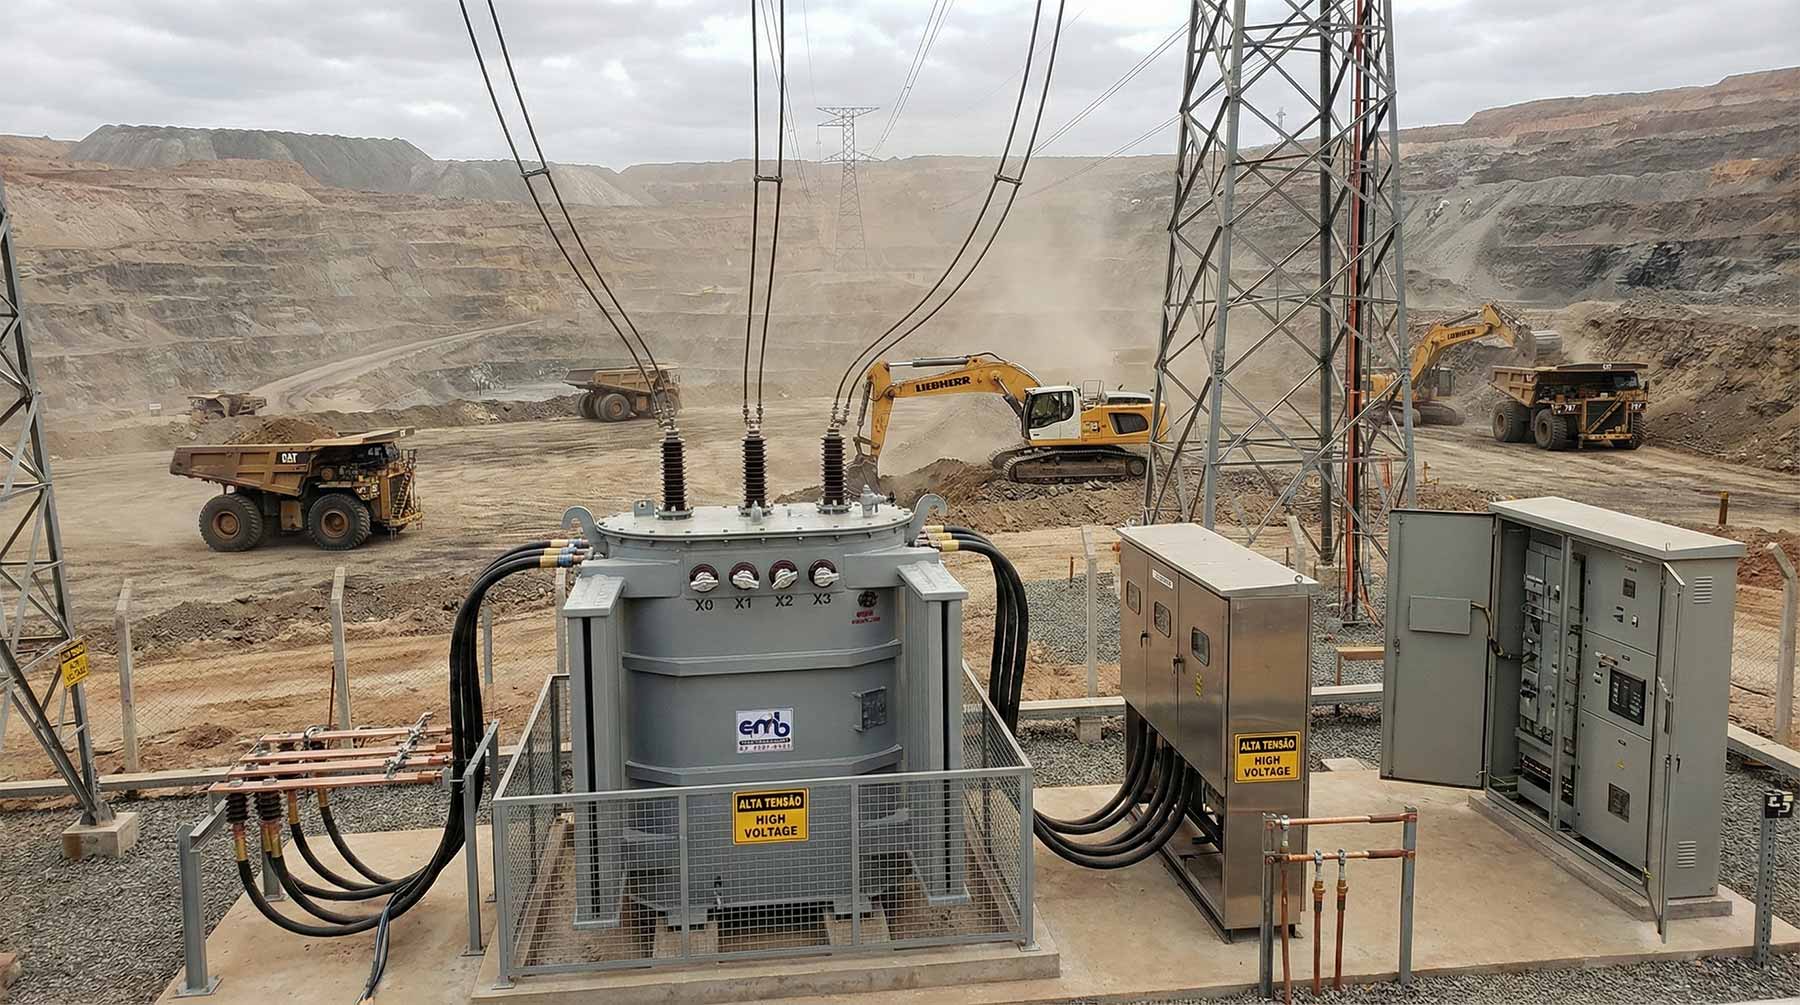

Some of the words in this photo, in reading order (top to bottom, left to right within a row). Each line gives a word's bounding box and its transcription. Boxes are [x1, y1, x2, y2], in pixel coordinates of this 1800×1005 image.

[916, 376, 970, 392] LIEBHERR
[736, 598, 751, 609] X1
[775, 595, 793, 607] X2
[813, 593, 832, 605] X3
[695, 600, 713, 611] X0
[1241, 741, 1260, 751] ALTA
[1255, 755, 1280, 765] HIGH
[1244, 766, 1290, 777] VOLTAGE
[739, 798, 762, 809] ALTA
[756, 814, 785, 824] HIGH
[744, 826, 798, 838] VOLTAGE
